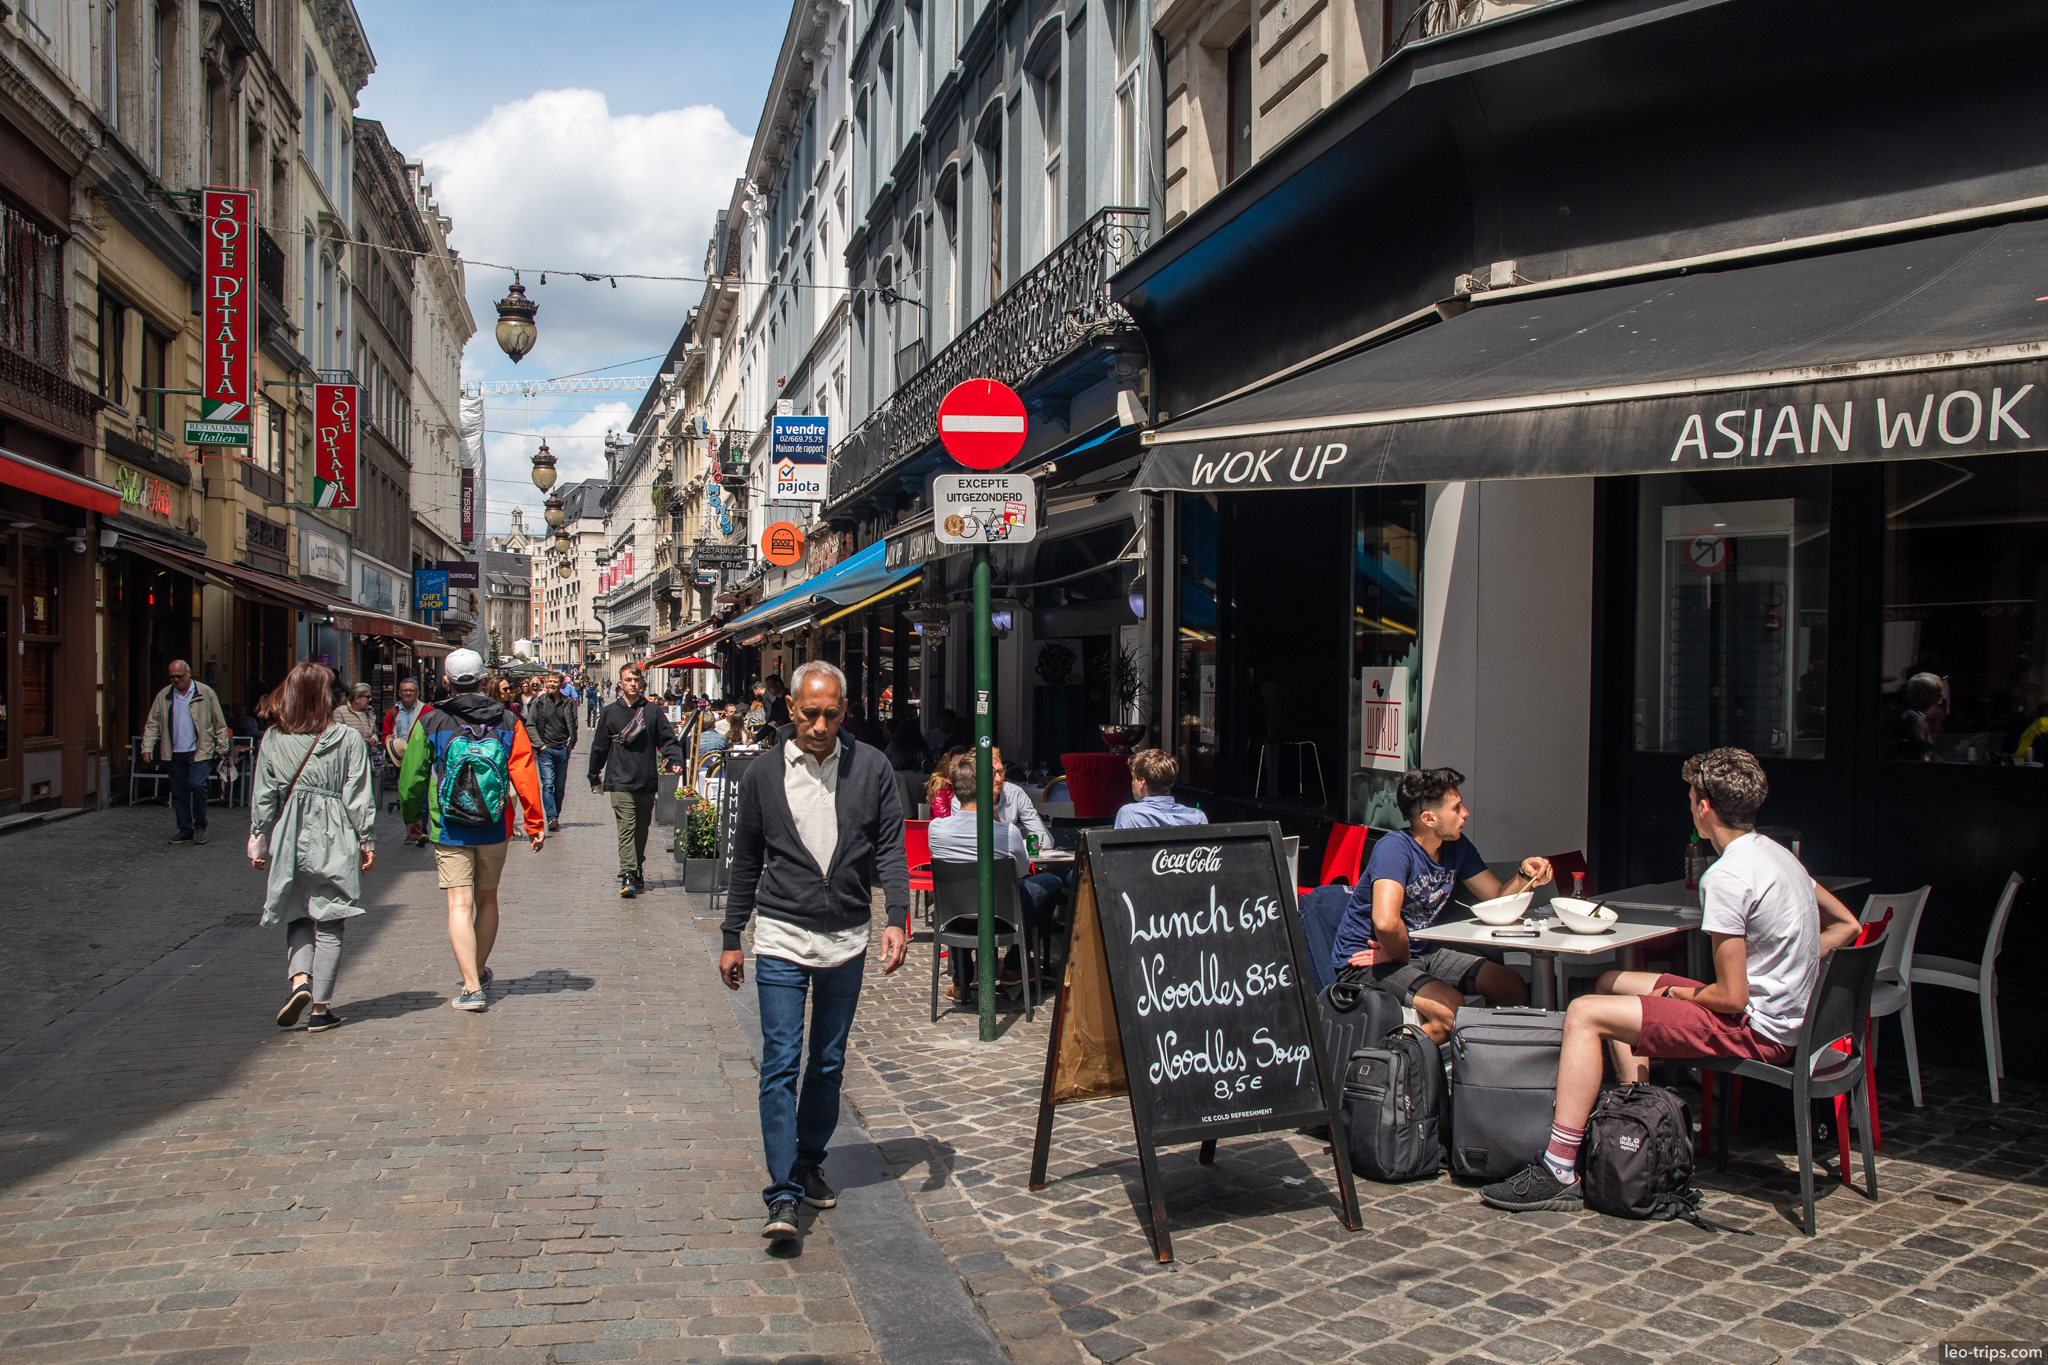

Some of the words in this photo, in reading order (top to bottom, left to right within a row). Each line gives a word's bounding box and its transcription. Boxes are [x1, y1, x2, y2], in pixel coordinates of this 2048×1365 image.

[211, 198, 240, 270] SOLE
[211, 275, 244, 395] D'ITALIA
[331, 387, 352, 434] SOLE
[1670, 400, 1853, 462] ASIAN
[1876, 383, 2035, 449] WOK
[189, 423, 247, 433] RESTAURANT
[197, 432, 237, 443] Italien
[775, 425, 783, 435] a
[785, 423, 826, 435] vendre
[779, 435, 823, 443] 02/669.75.75
[775, 444, 795, 453] Maison
[795, 444, 802, 453] de
[803, 444, 824, 455] rapport
[318, 425, 352, 504] D'ITALIA
[1191, 447, 1284, 486] WOK
[1289, 442, 1348, 482] UP
[115, 465, 140, 505] Sole
[777, 479, 820, 494] pajota
[946, 492, 1023, 502] UITGEZONDERD
[958, 479, 1009, 488] EXCEPTE
[463, 486, 472, 523] safestay
[707, 484, 733, 534] MONDO
[697, 546, 744, 554] RESTAURANT
[419, 600, 444, 609] SHOP
[421, 593, 441, 601] GIFT
[1151, 845, 1223, 876] Coca-Cola
[1121, 884, 1234, 944] Lunch
[1239, 895, 1280, 934] 6,5€
[1137, 951, 1245, 1016] Noodles
[1245, 962, 1292, 997] 8,5€
[1149, 1029, 1247, 1085] Noodles
[1252, 1027, 1311, 1086] Soup
[1214, 1074, 1263, 1099] 8,5€
[1213, 1113, 1230, 1122] COLD
[1230, 1107, 1273, 1119] REFRESHMENT
